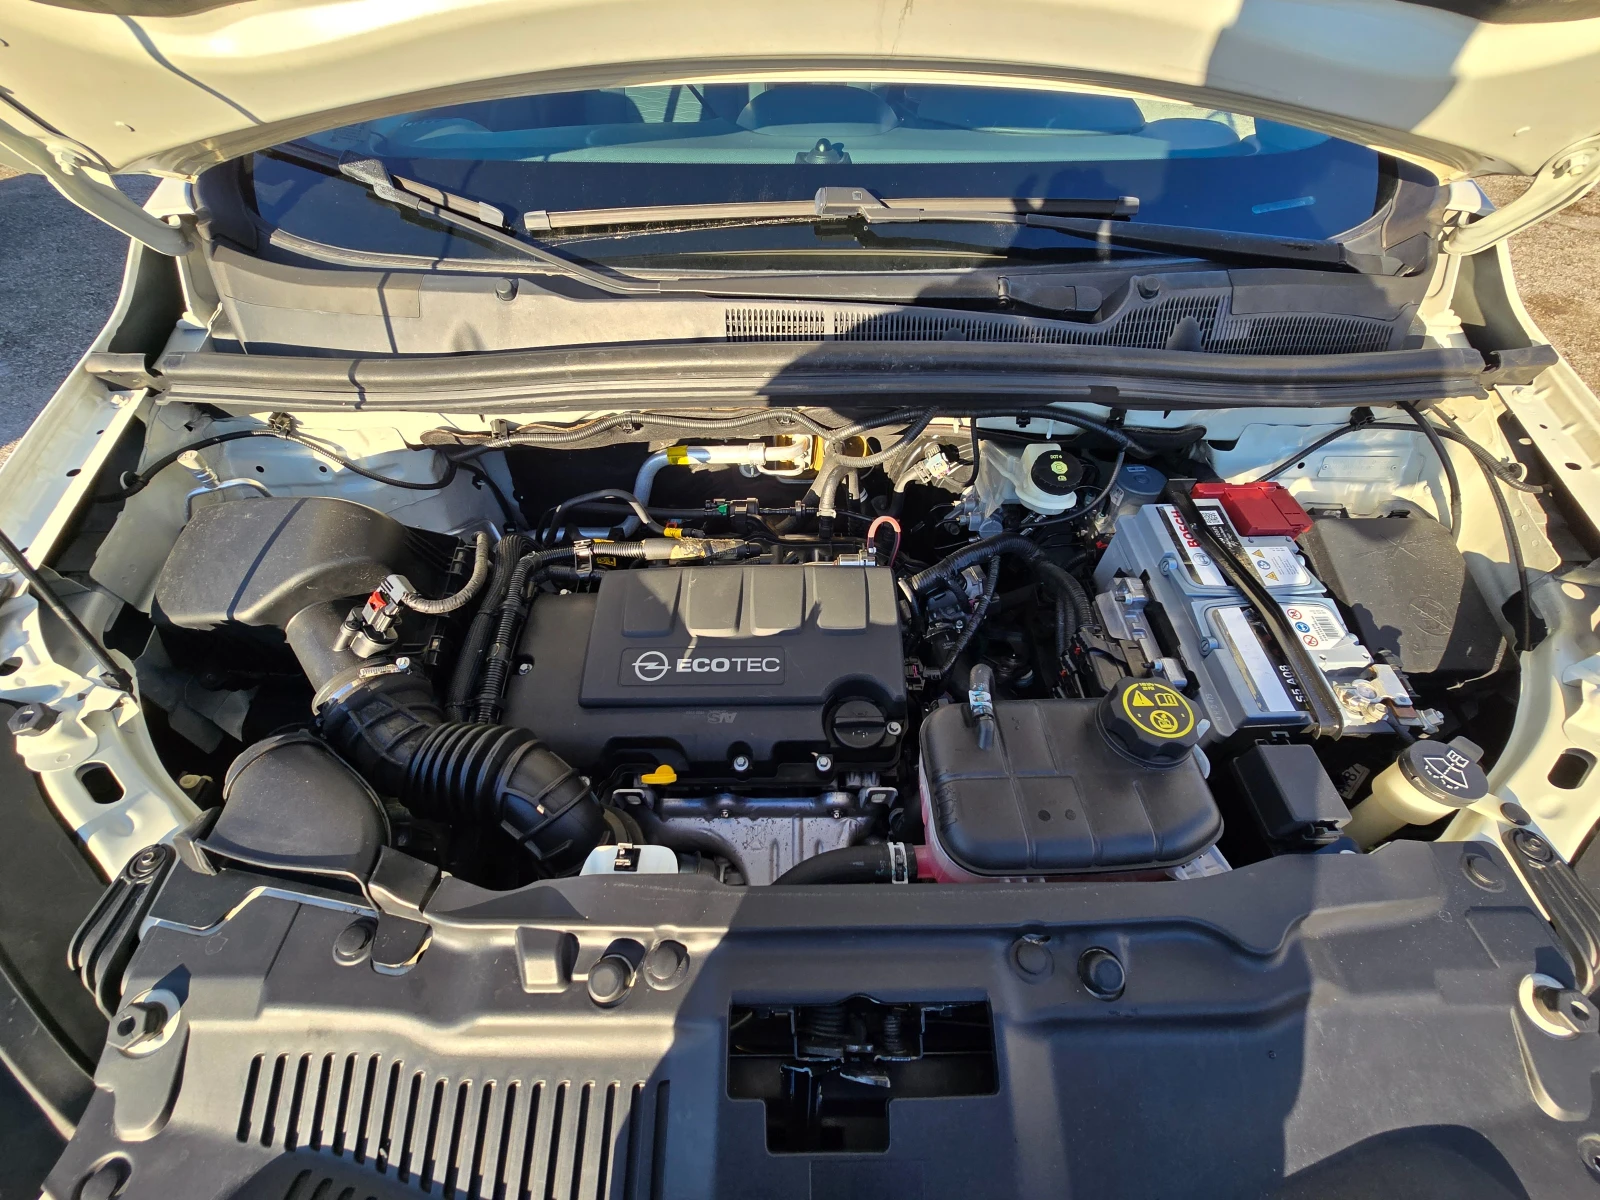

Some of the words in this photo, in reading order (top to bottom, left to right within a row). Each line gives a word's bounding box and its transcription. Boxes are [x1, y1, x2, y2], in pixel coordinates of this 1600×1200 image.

[1171, 510, 1201, 548] BOSCH
[676, 657, 780, 673] ECOTEC
[1279, 664, 1297, 685] A08
[1291, 688, 1306, 703] S5
